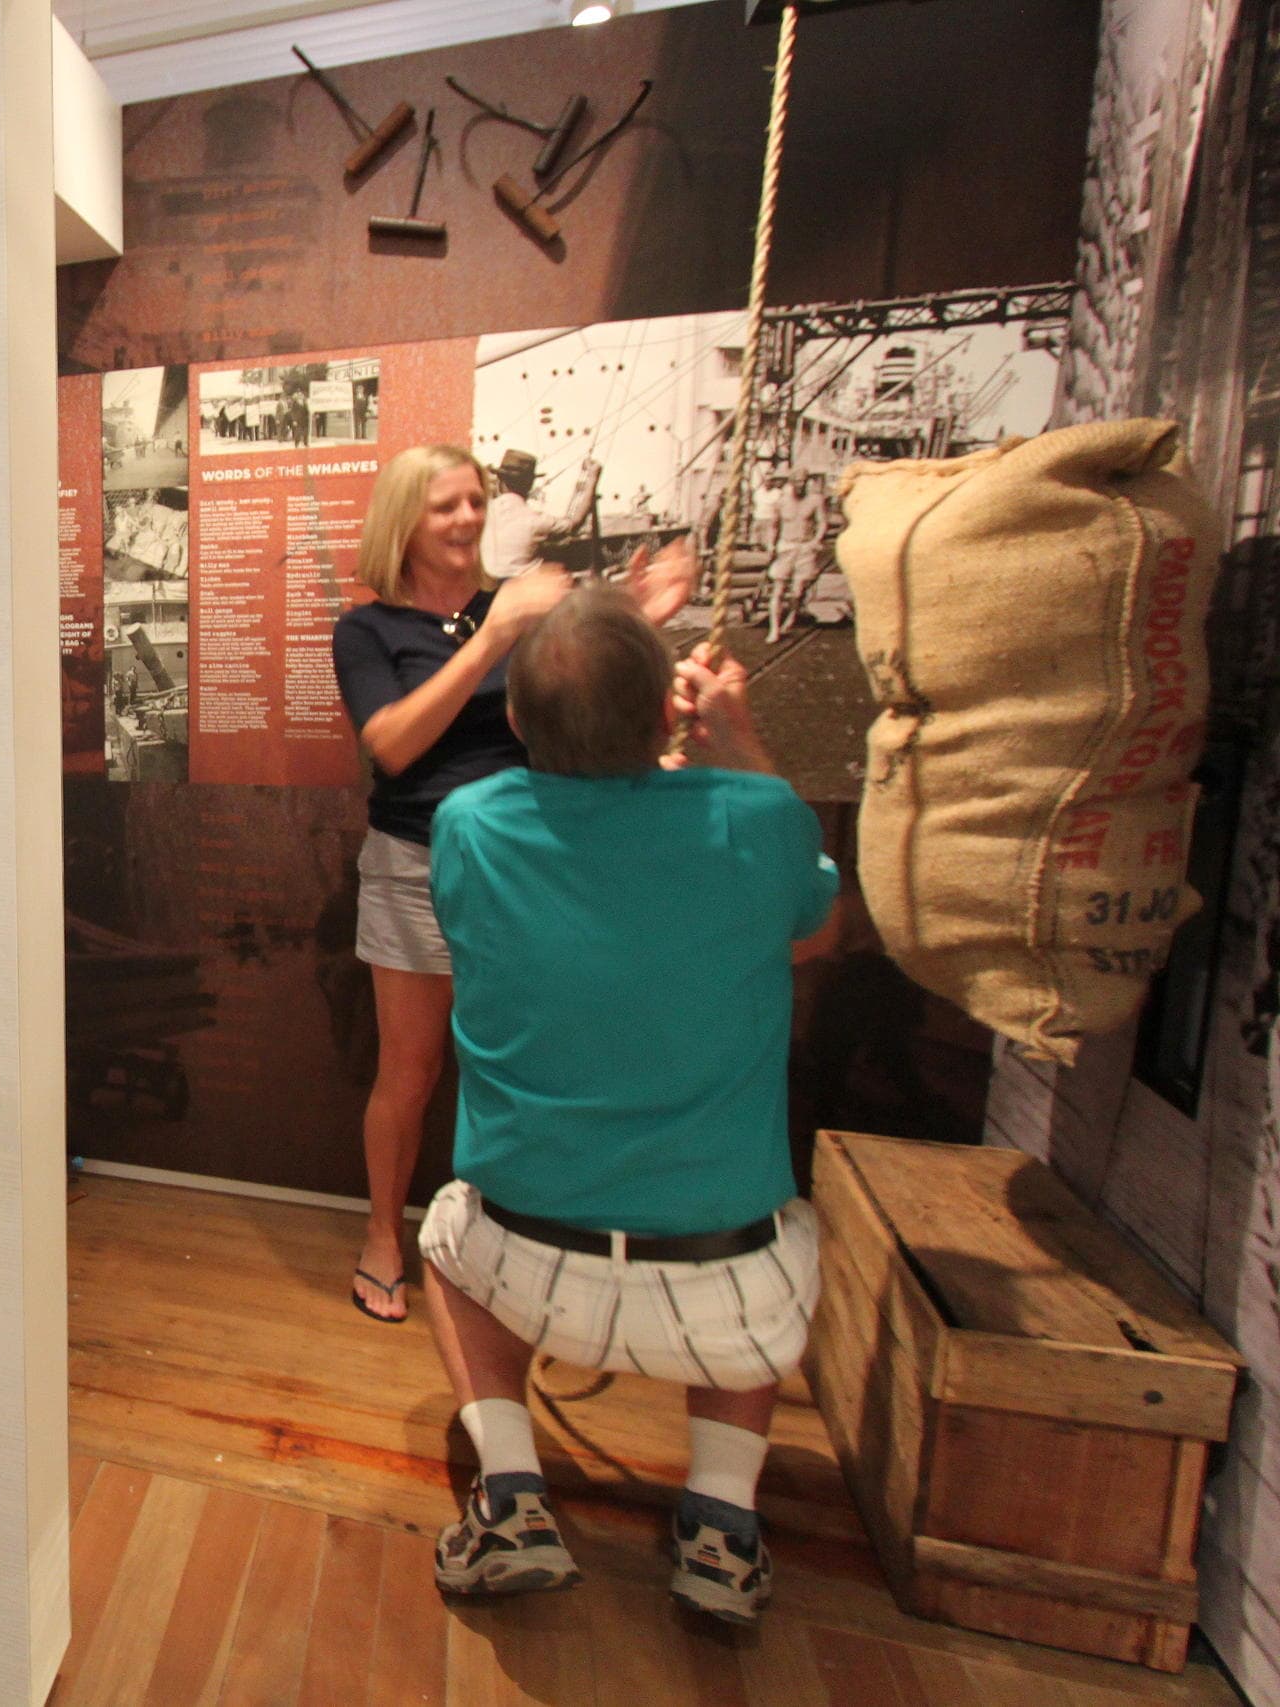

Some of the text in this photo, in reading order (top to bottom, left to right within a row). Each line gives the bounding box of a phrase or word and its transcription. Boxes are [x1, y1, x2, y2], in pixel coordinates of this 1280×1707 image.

[202, 460, 378, 482] WORDS OF THE WHARVES
[1144, 537, 1196, 713] PADDOCK
[1120, 720, 1175, 768] TO
[1086, 890, 1131, 925] 31
